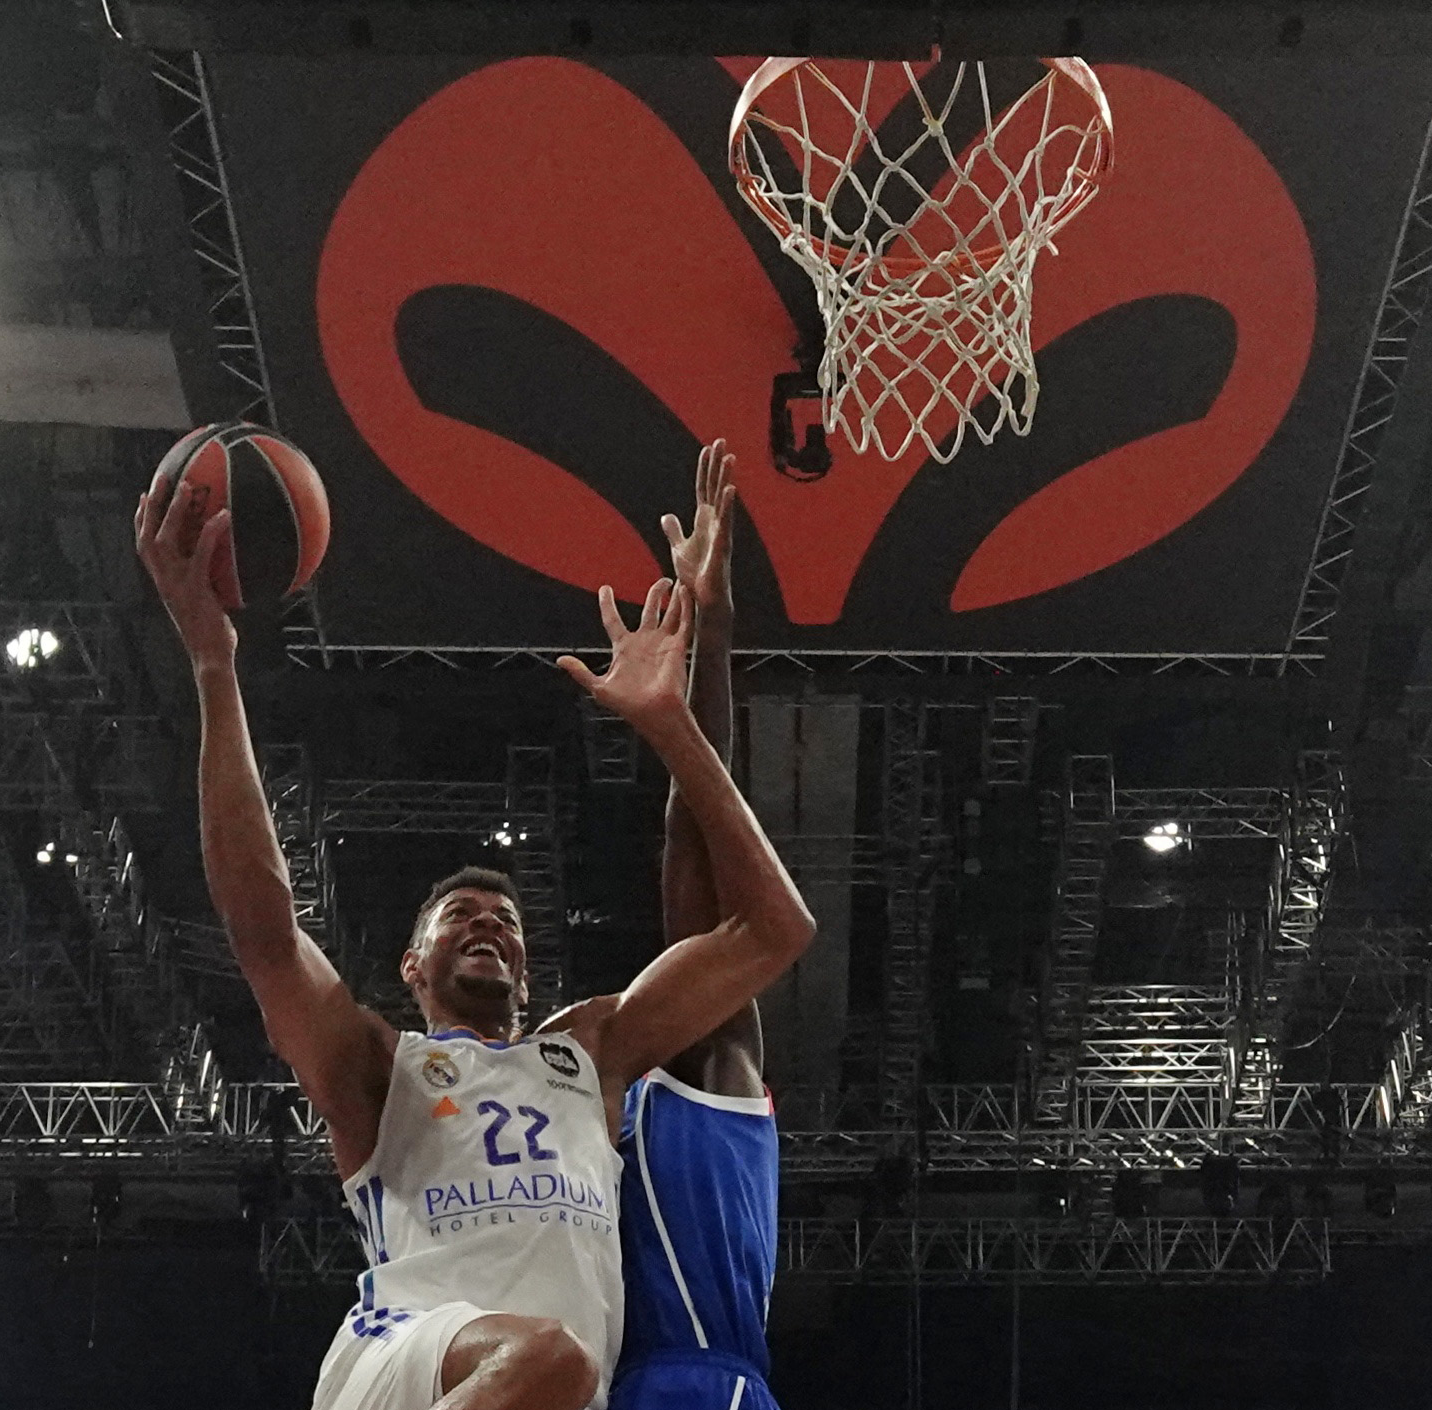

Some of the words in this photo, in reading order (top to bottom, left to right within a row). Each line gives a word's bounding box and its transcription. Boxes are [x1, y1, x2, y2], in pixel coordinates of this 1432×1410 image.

[478, 1100, 558, 1166] 22
[430, 1211, 516, 1237] HOTEL
[539, 1210, 613, 1235] GROUP
